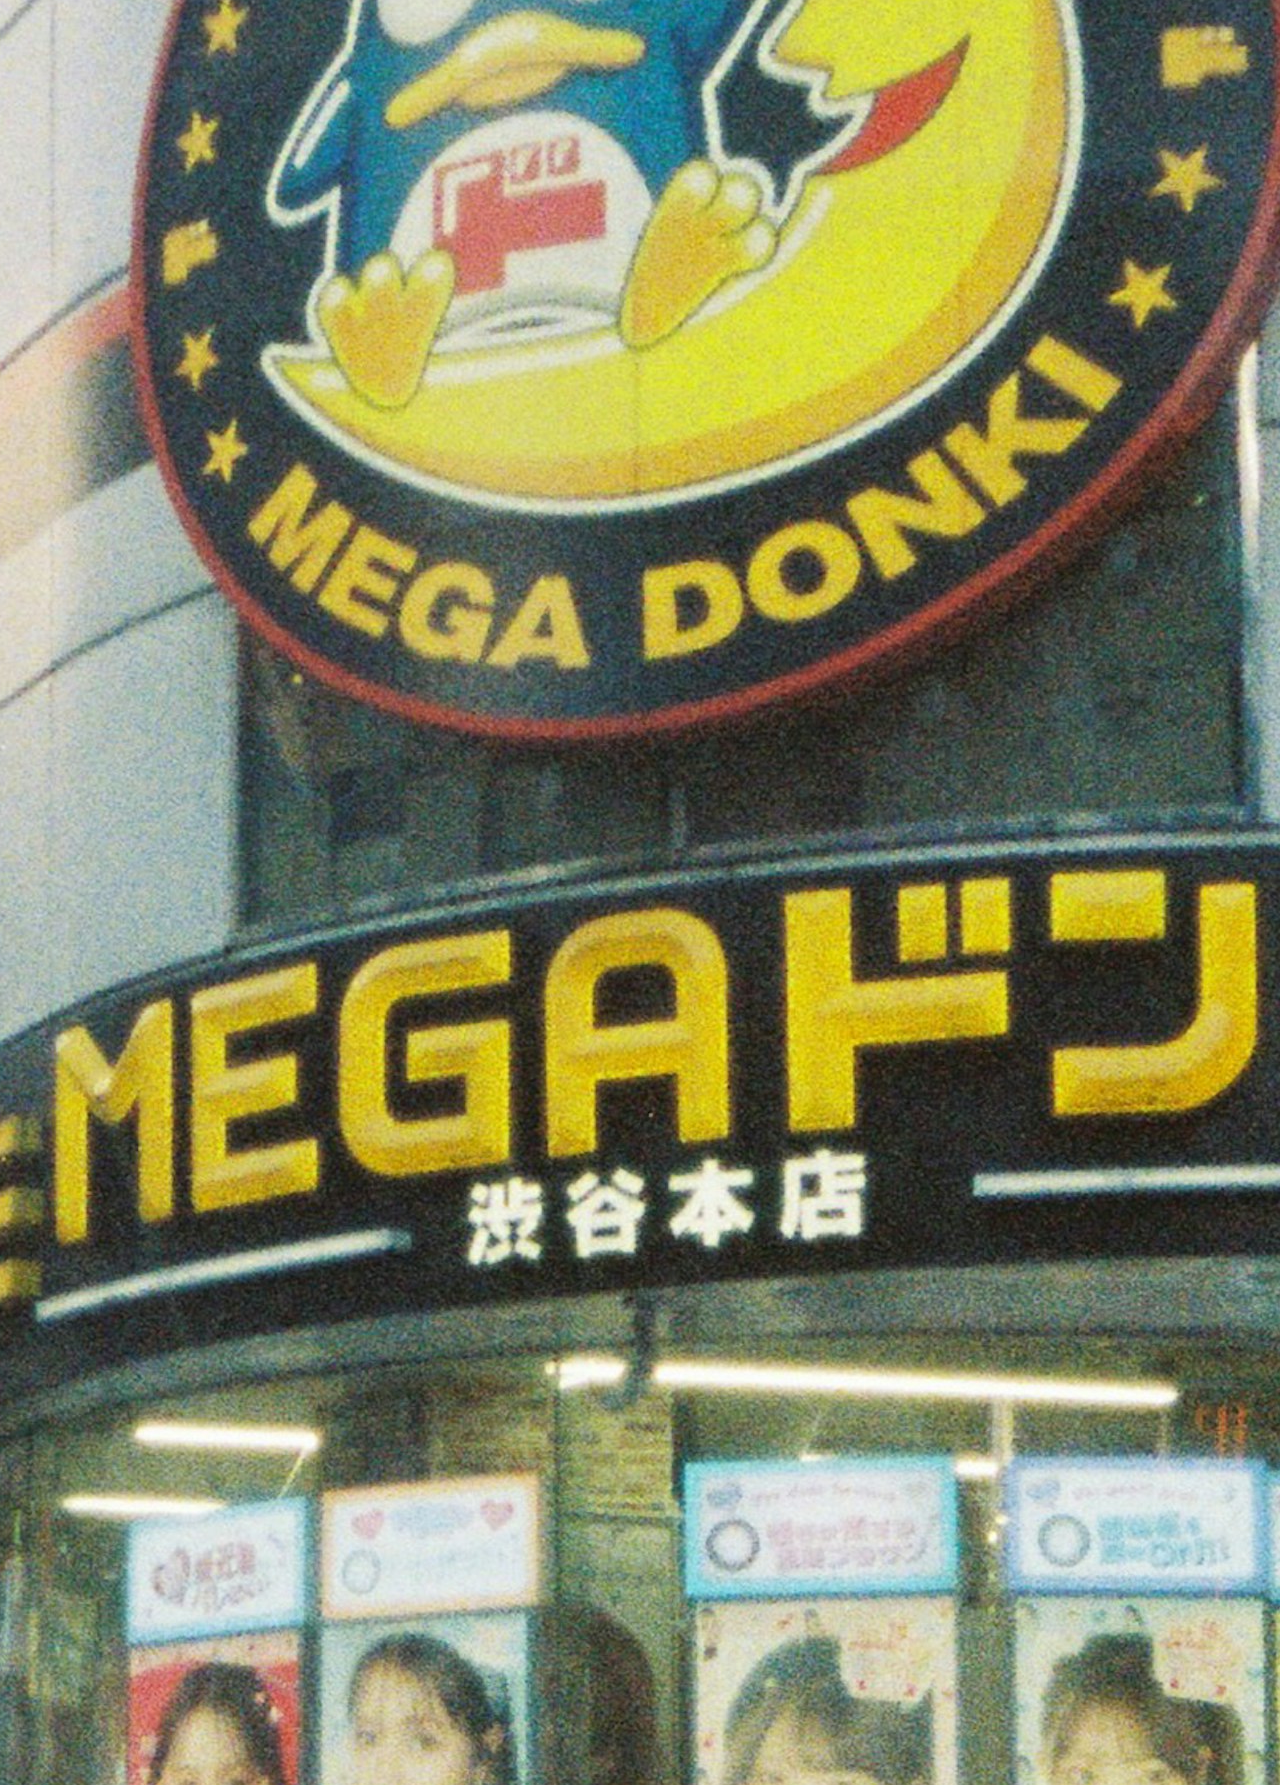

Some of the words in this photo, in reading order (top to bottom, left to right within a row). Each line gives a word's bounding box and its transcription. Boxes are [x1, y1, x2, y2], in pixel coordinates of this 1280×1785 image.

[245, 462, 590, 669] MEGA
[639, 334, 1124, 663] DONKI
[466, 1147, 868, 1267] 渋谷本店
